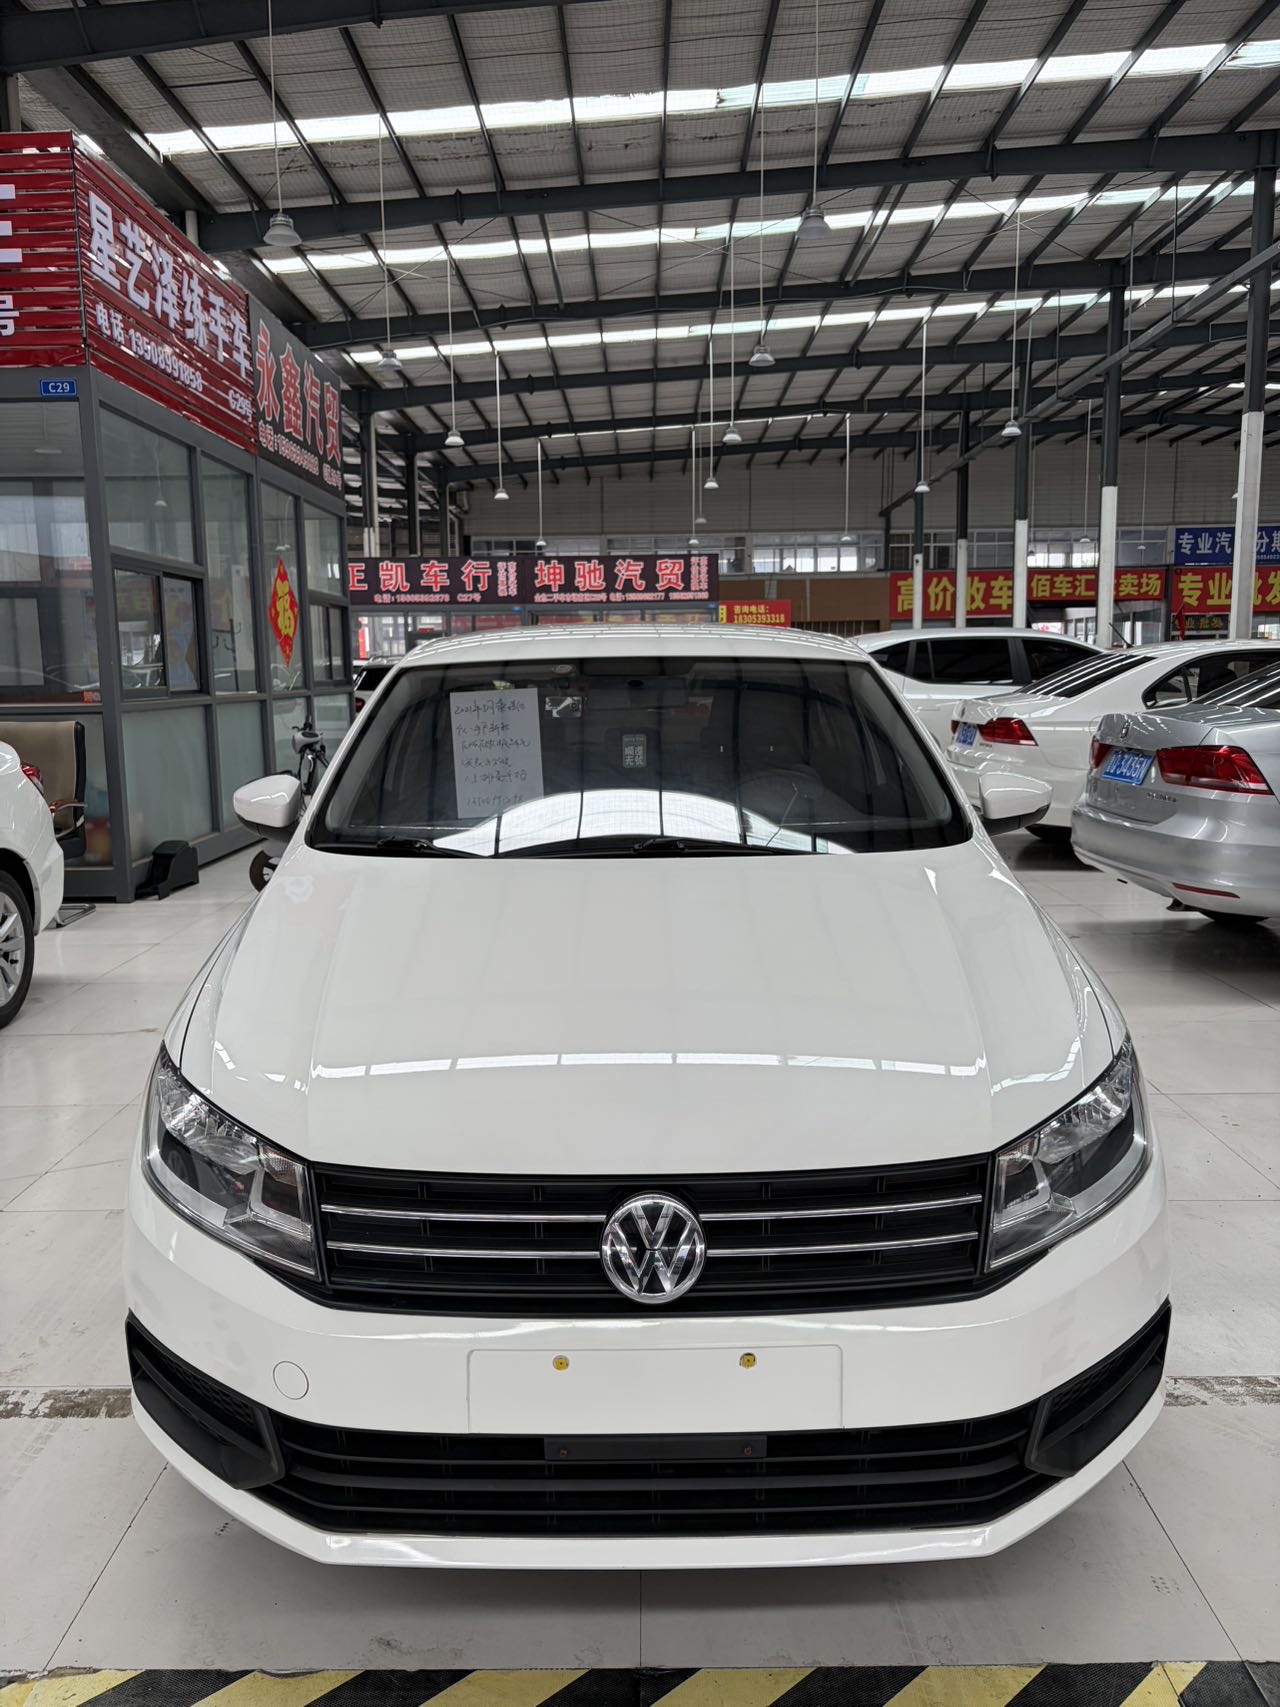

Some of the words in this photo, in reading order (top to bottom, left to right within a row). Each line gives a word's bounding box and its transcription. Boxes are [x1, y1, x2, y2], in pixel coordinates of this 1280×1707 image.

[88, 190, 254, 379] 星艺泽练手车
[95, 302, 126, 345] 电话
[47, 382, 70, 394] C29
[255, 318, 342, 467] 永鑫汽贸
[1178, 530, 1280, 555] 专业汽分期
[534, 558, 685, 592] 坤驰汽贸
[1030, 573, 1162, 598] 佰车汇卖场
